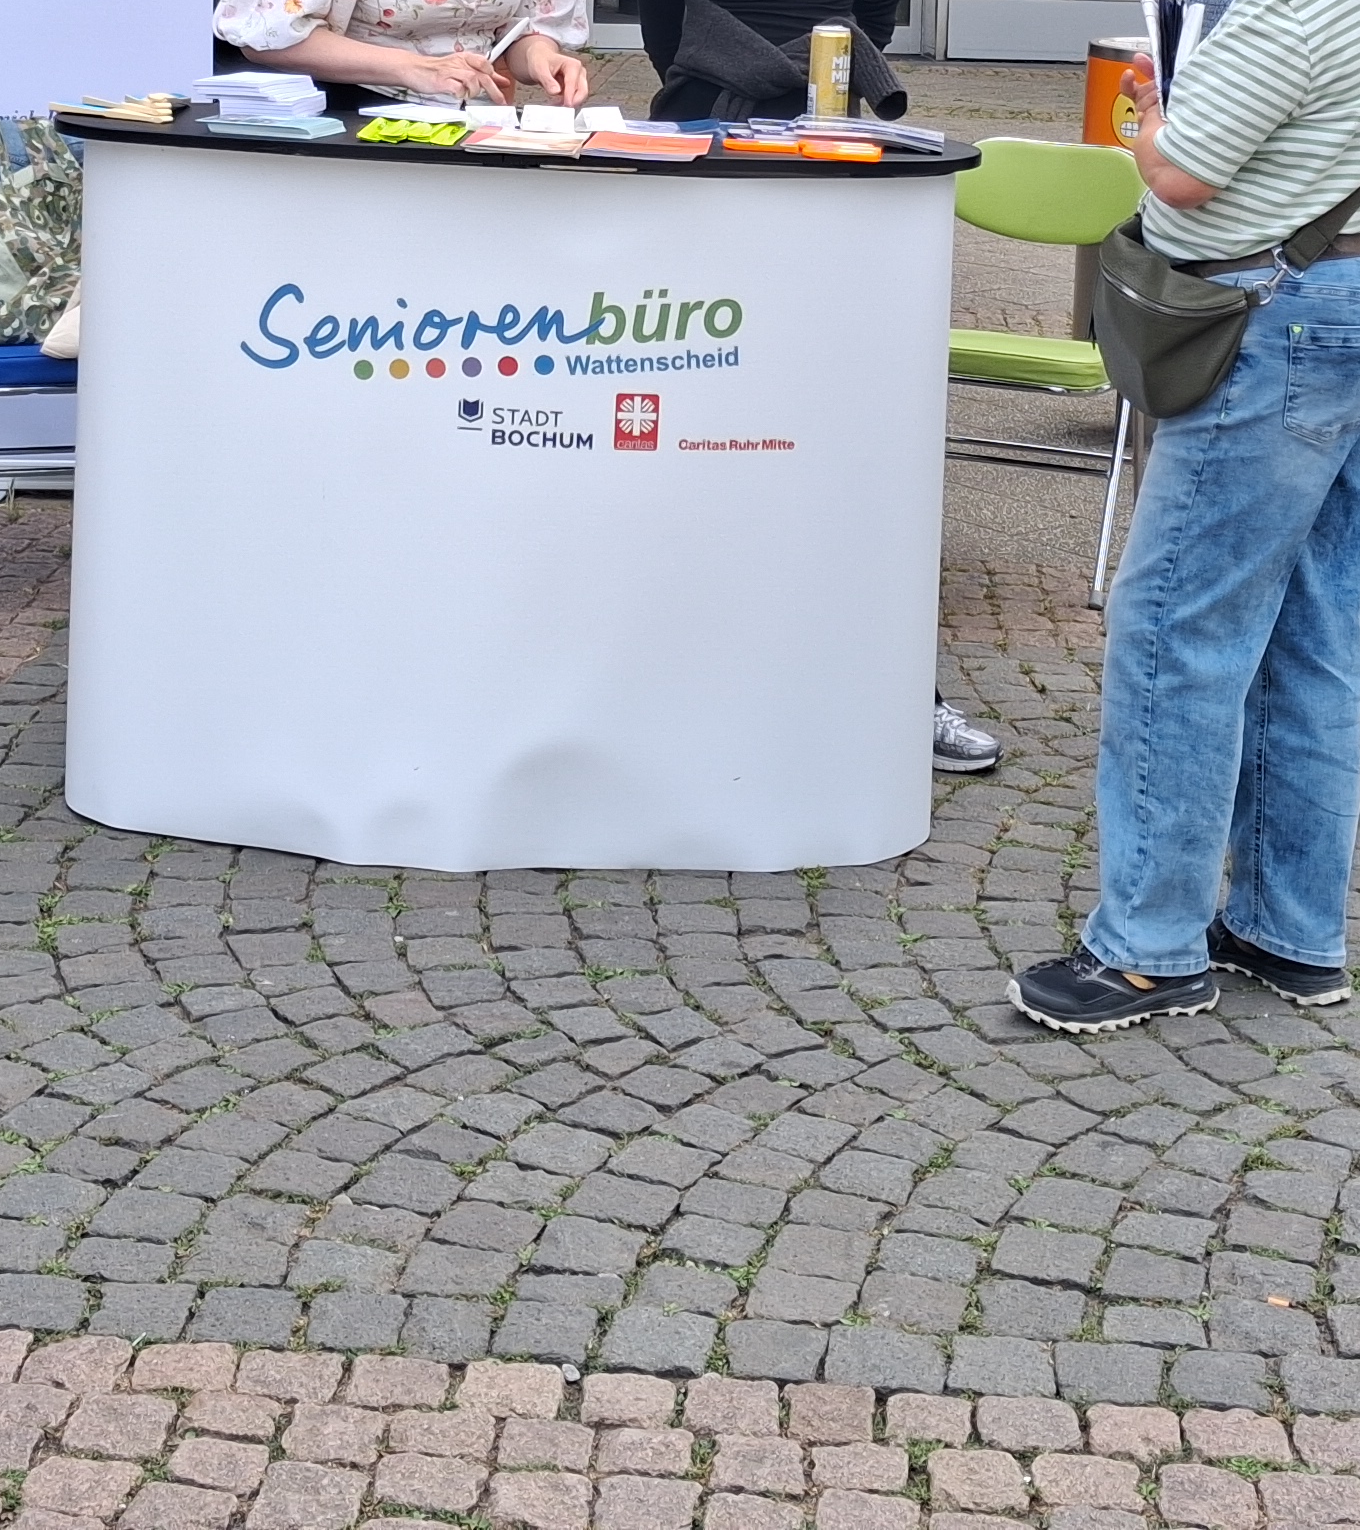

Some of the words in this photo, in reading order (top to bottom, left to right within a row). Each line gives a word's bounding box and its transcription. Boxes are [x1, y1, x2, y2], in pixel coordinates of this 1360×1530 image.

[240, 282, 743, 369] Seniorenbüro
[566, 347, 740, 376] Wattenscheid
[492, 407, 563, 427] STADT
[491, 428, 594, 450] BOCHUM
[678, 438, 727, 451] Caritas
[729, 438, 760, 451] Ruhr
[762, 438, 795, 451] Mitte
